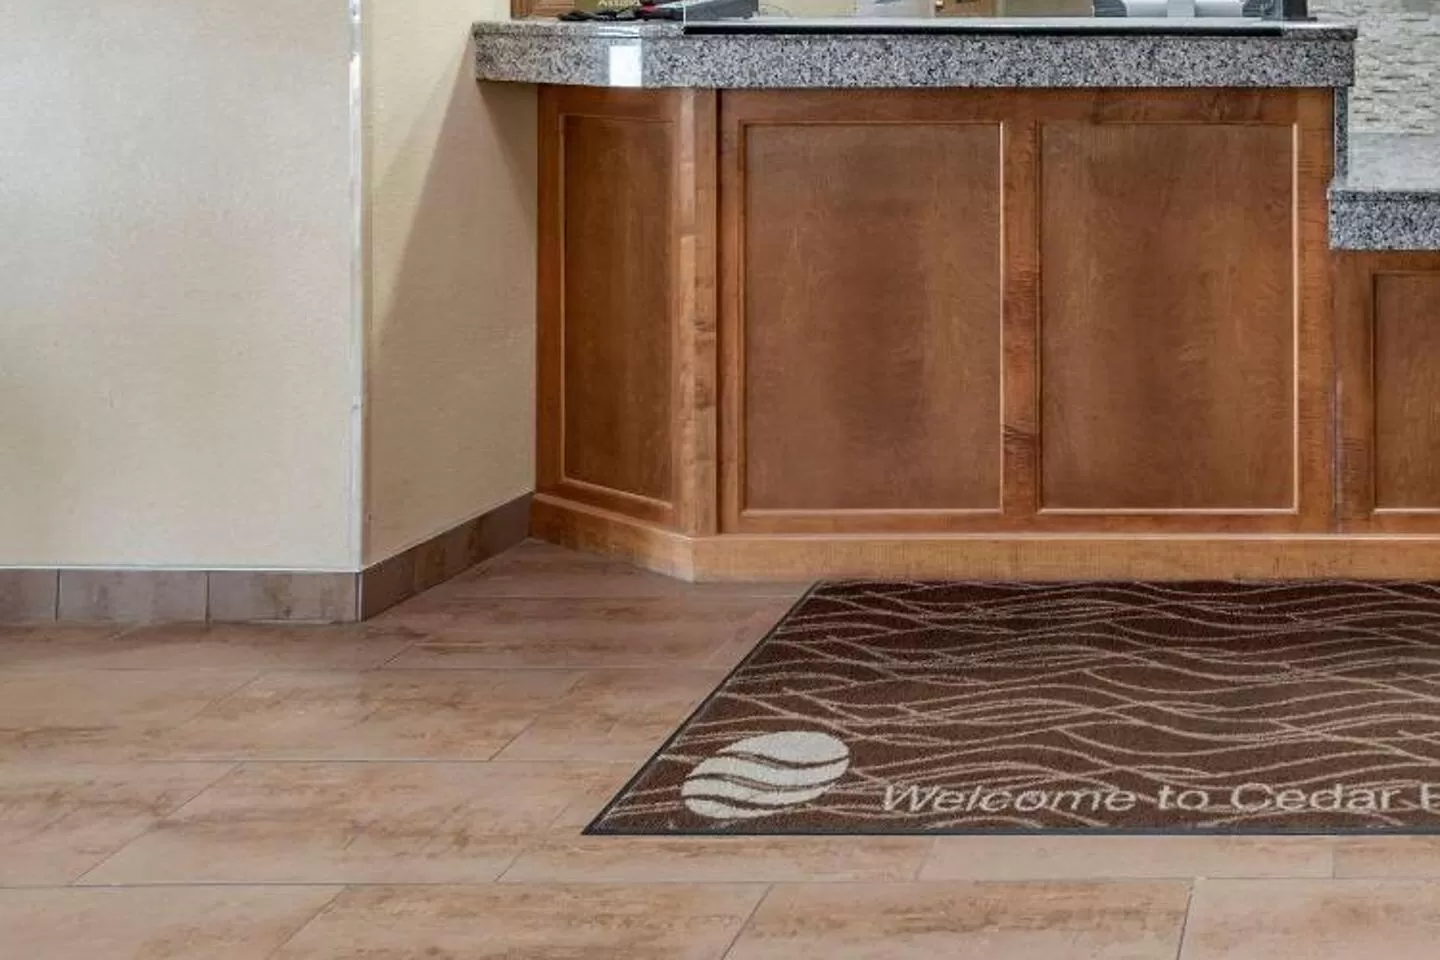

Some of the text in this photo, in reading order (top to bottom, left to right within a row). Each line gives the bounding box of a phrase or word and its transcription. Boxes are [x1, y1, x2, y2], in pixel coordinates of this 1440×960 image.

[880, 783, 1137, 813] Welcome
[1156, 783, 1209, 812] to
[1229, 781, 1402, 813] Cedar
